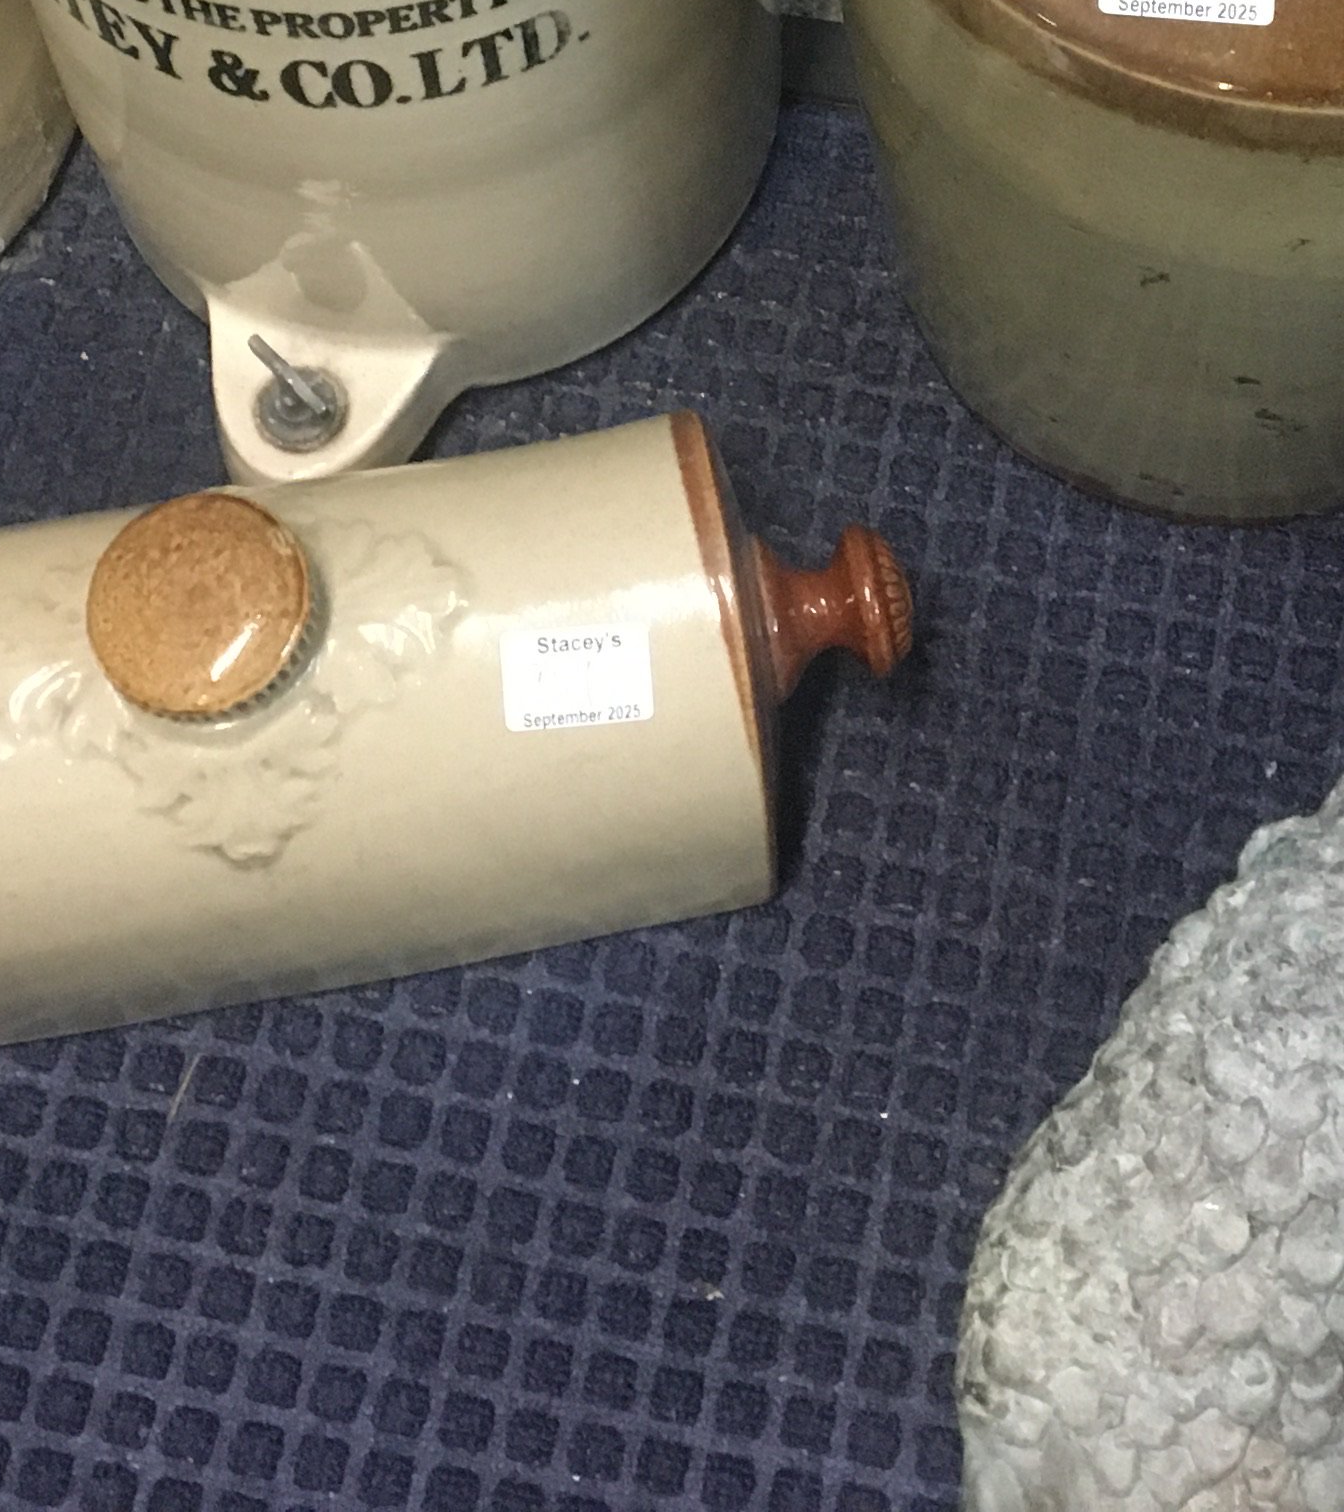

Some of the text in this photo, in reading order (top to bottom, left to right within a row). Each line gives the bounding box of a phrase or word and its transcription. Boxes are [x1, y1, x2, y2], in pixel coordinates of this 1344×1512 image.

[1218, 2, 1258, 22] 2025
[207, 48, 271, 102] &
[279, 59, 412, 109] CO.
[409, 8, 591, 101] LTD.
[537, 632, 622, 654] Stacey's
[523, 704, 641, 729] September 2025
